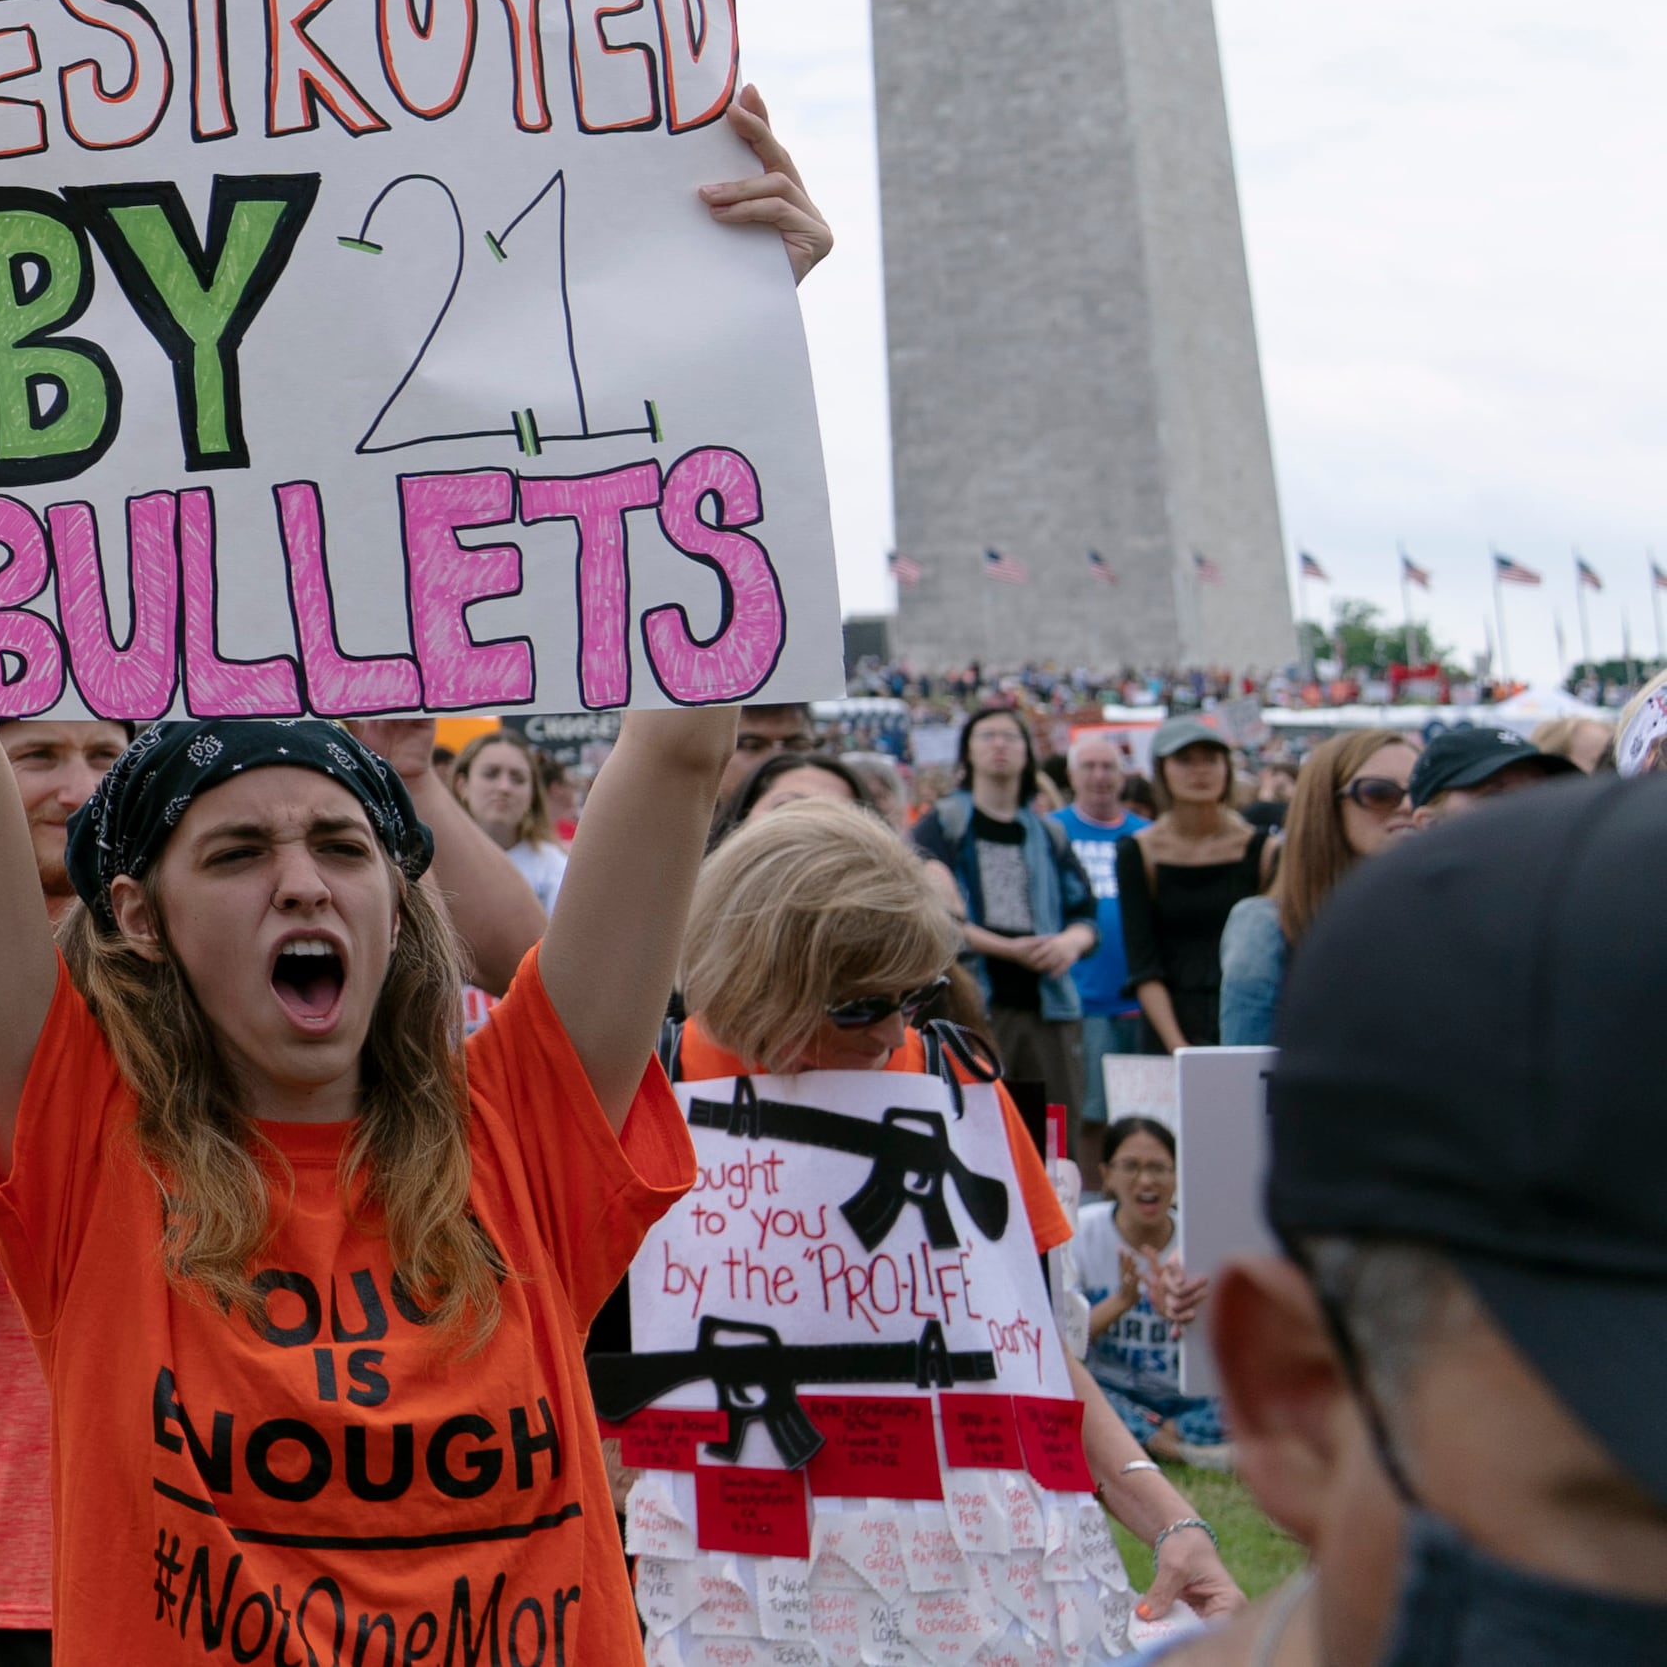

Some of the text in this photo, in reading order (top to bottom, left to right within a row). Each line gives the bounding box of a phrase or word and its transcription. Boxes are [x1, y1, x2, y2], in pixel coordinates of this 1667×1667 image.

[337, 169, 663, 456] 21
[692, 1148, 785, 1210] ought
[691, 1202, 827, 1250] to you
[663, 1241, 707, 1319] by
[722, 1247, 798, 1306] the
[313, 1347, 390, 1407] IS
[987, 1309, 1042, 1384] party
